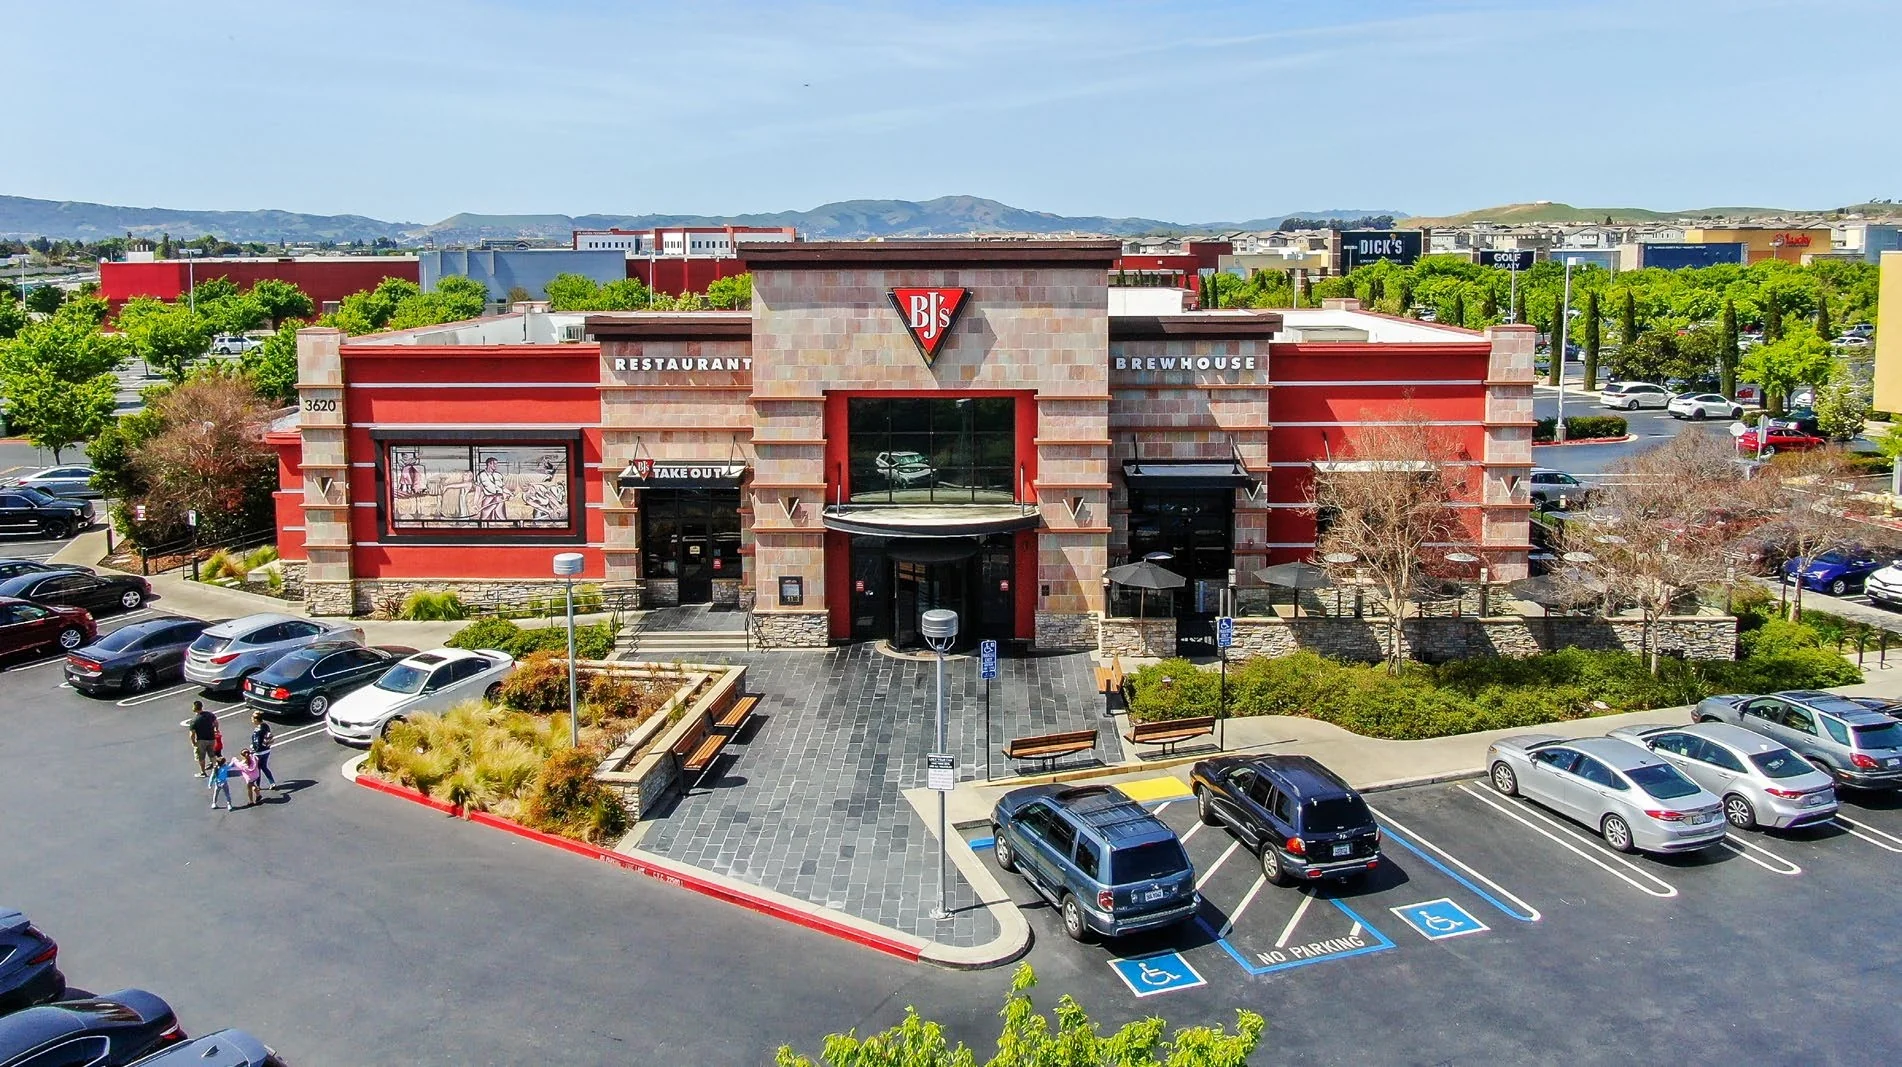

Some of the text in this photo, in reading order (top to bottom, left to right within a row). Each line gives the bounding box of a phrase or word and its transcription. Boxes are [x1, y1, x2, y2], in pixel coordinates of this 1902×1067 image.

[1360, 239, 1403, 255] DICK'S
[1493, 253, 1521, 262] GOLF
[909, 292, 951, 339] BJ's
[615, 358, 752, 371] RESTAURANT
[1115, 357, 1255, 370] BREWHOUSE
[305, 399, 336, 412] 3620
[653, 468, 722, 479] TAKE OUT
[1256, 936, 1365, 965] NO PARKING
